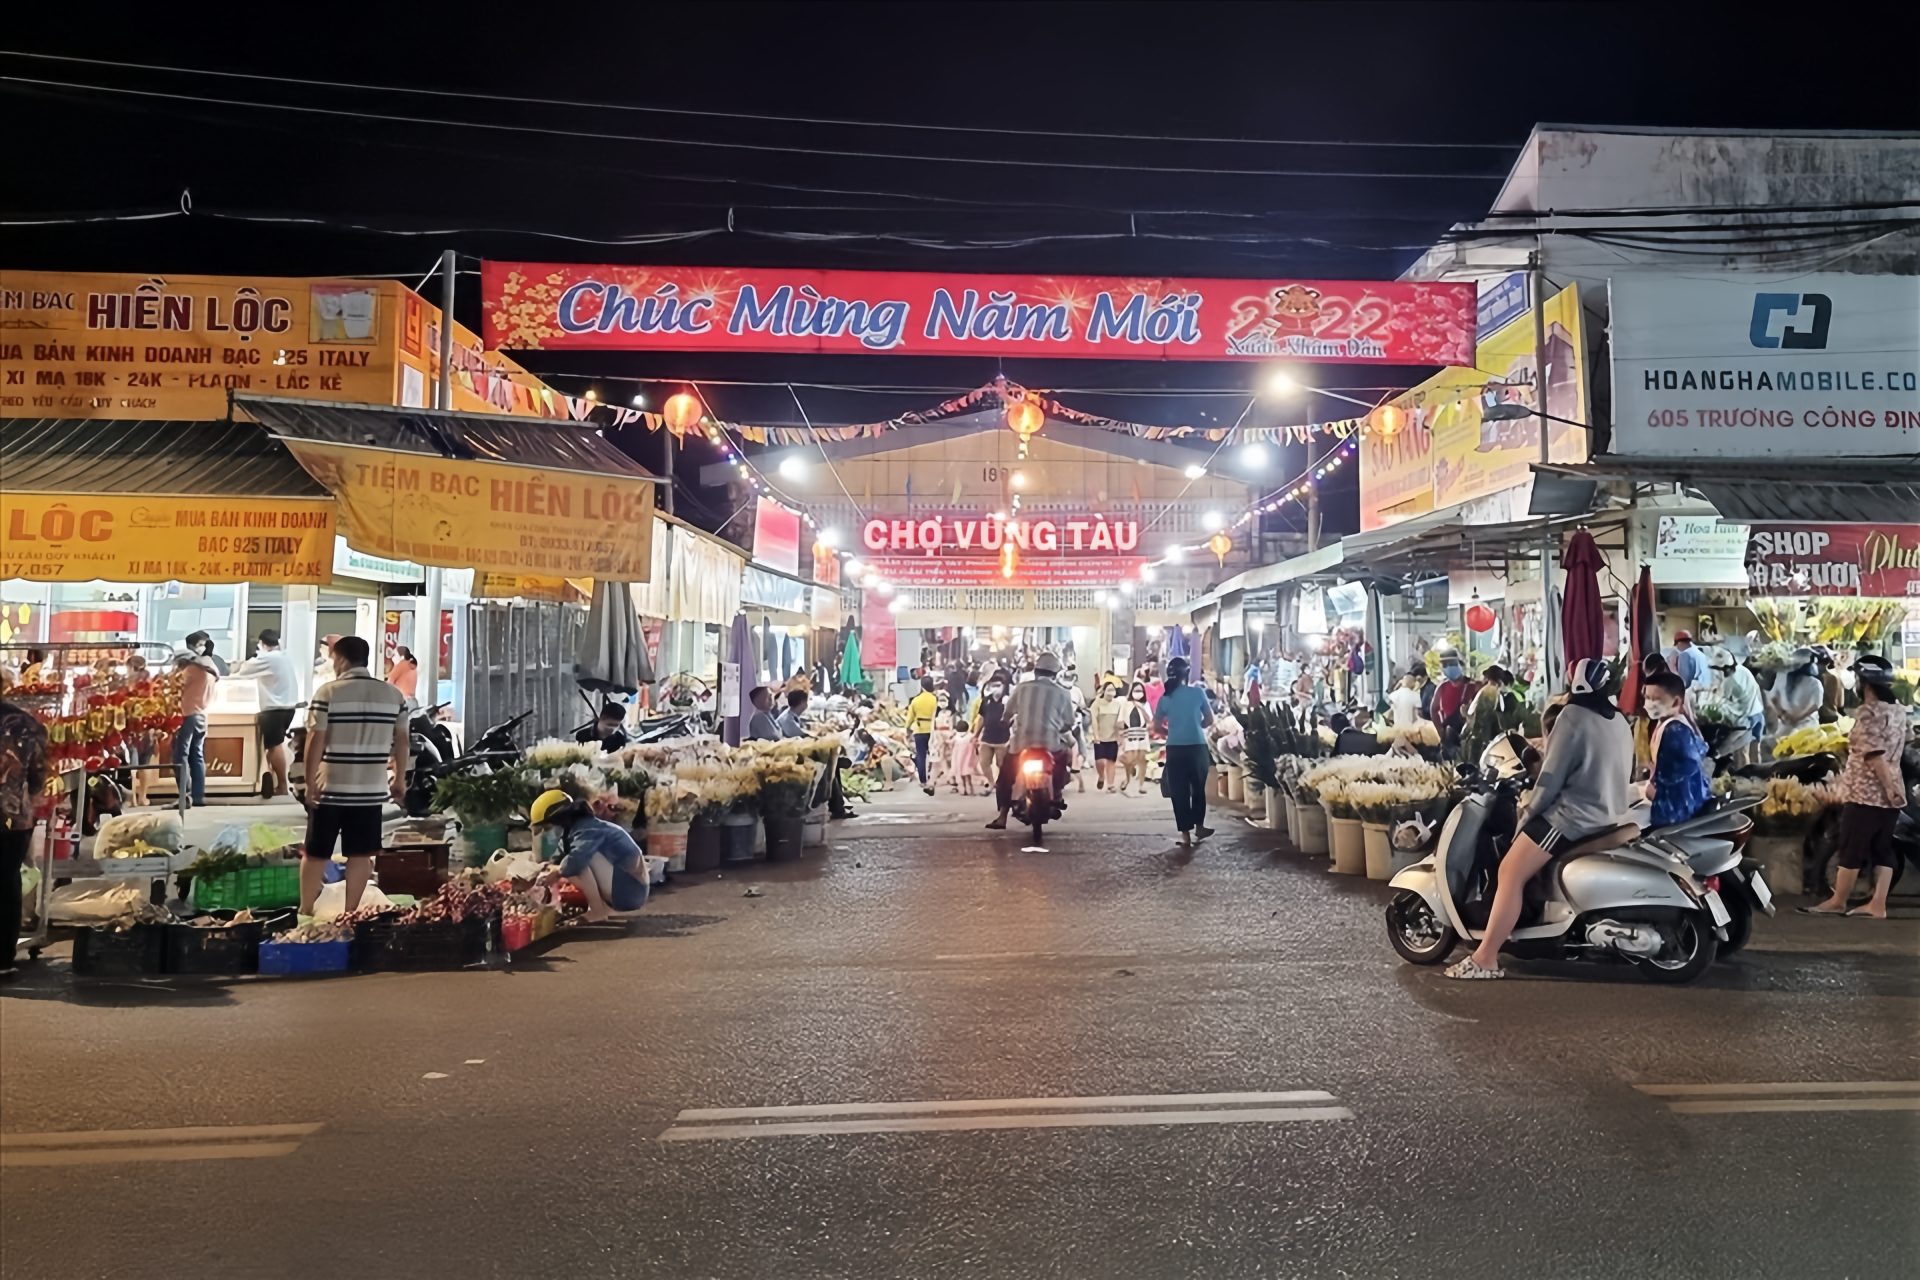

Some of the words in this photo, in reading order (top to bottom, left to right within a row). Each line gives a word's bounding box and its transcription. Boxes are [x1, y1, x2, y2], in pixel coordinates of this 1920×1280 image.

[87, 277, 193, 332] HIỀN
[205, 286, 292, 342] LỘC
[556, 280, 713, 334] Chúc
[728, 284, 911, 350] Mừng
[923, 287, 1074, 342] Năm
[1086, 287, 1203, 345] Mới
[86, 345, 135, 362] KINH
[144, 346, 212, 364] DOANH
[222, 347, 261, 368] BẠC
[273, 349, 308, 366] 25
[319, 349, 371, 368] ITALY
[6, 370, 25, 385] XI
[127, 372, 162, 388] 24K
[1644, 369, 1917, 391] HOANGHAMOBILE.CO
[1647, 409, 1689, 428] 605
[1696, 407, 1795, 429] TRƯƠNG
[1803, 405, 1876, 428] CÔNG
[356, 461, 421, 494] TIỆM
[430, 471, 480, 500] BẠC
[583, 483, 644, 529] LỘC
[8, 502, 114, 548] LỘC
[175, 510, 206, 528] MUA
[243, 511, 277, 529] KINH
[281, 512, 328, 530] DOANH
[198, 536, 228, 557] BẠC
[233, 537, 260, 554] 925
[265, 536, 303, 555] ITALY
[863, 515, 943, 557] CHỢ
[953, 512, 1058, 551] VŨNG
[1066, 513, 1139, 551] TÀU
[1753, 530, 1831, 557] SHOP
